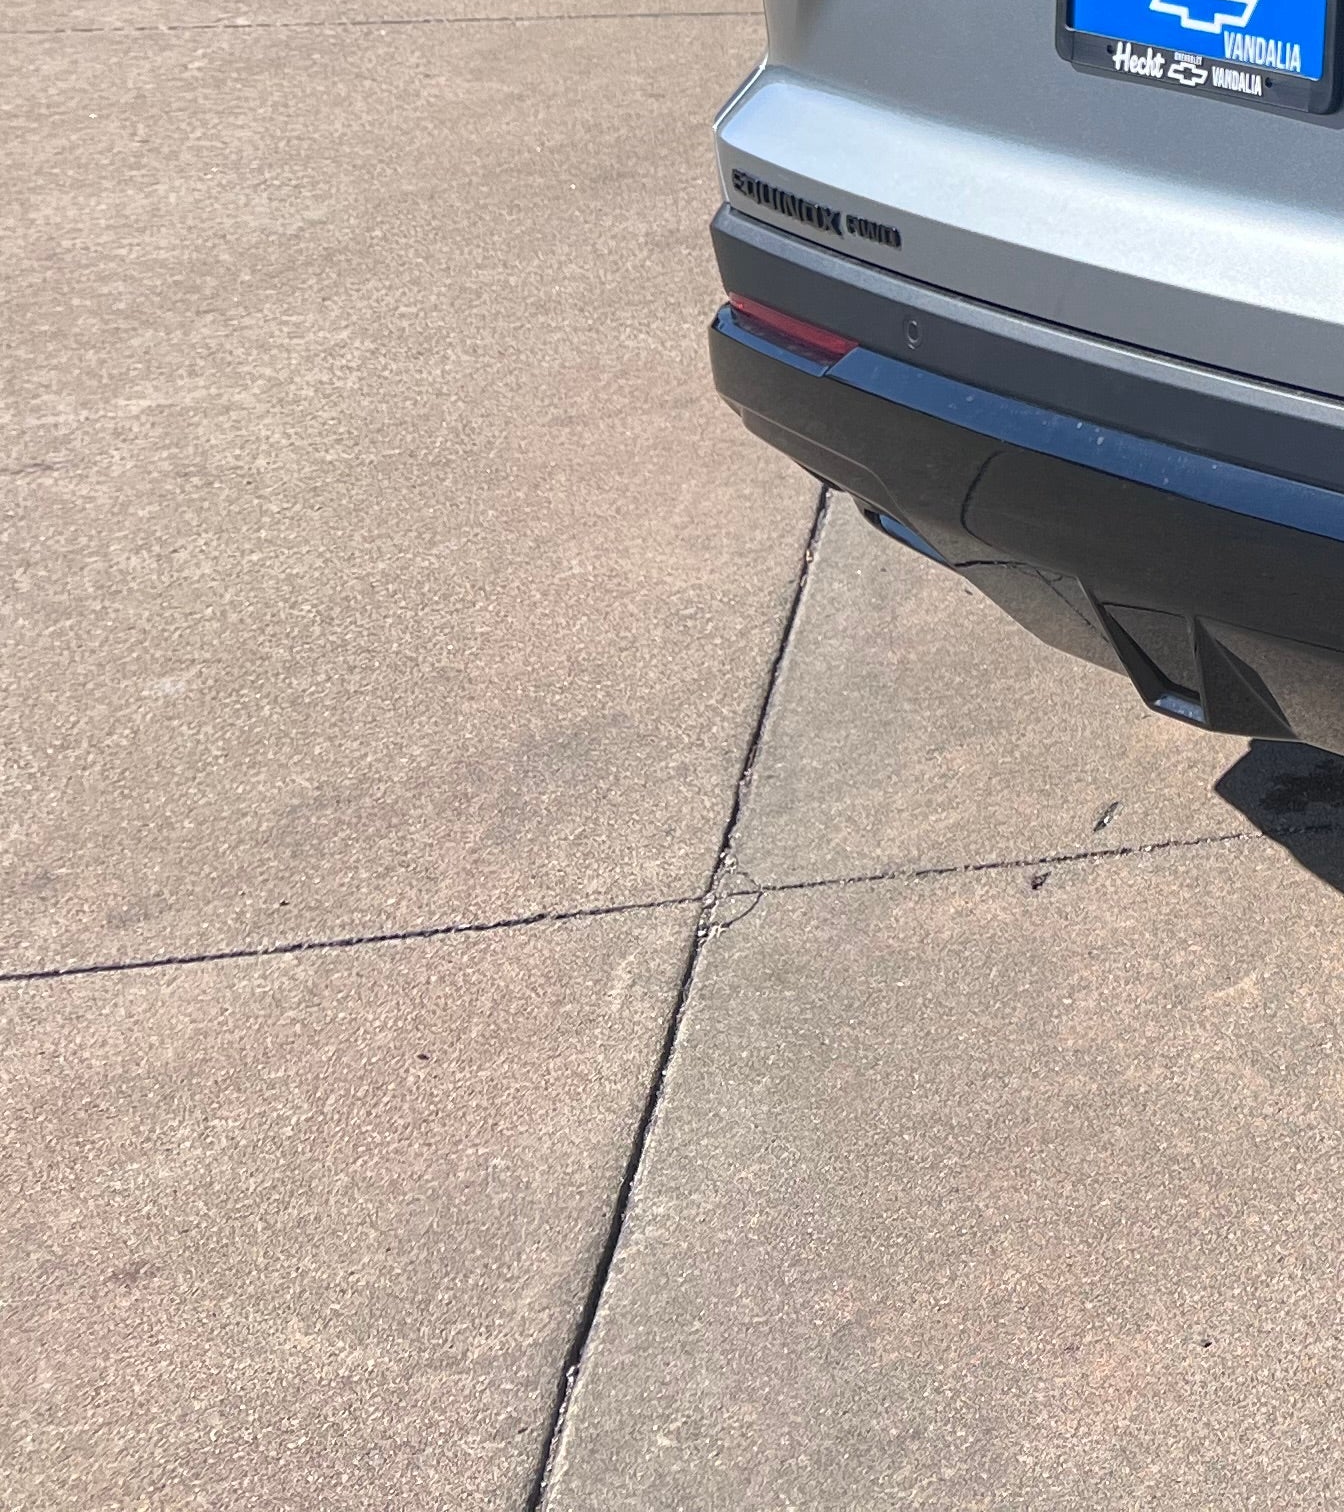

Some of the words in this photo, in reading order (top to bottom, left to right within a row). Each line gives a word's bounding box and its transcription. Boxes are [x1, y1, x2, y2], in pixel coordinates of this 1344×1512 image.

[1112, 41, 1165, 79] Hecht
[1173, 51, 1203, 65] CHEVROLET
[1223, 30, 1302, 73] VANDALIA
[1211, 65, 1263, 97] VANDALIA
[731, 167, 843, 238] EQUINOX
